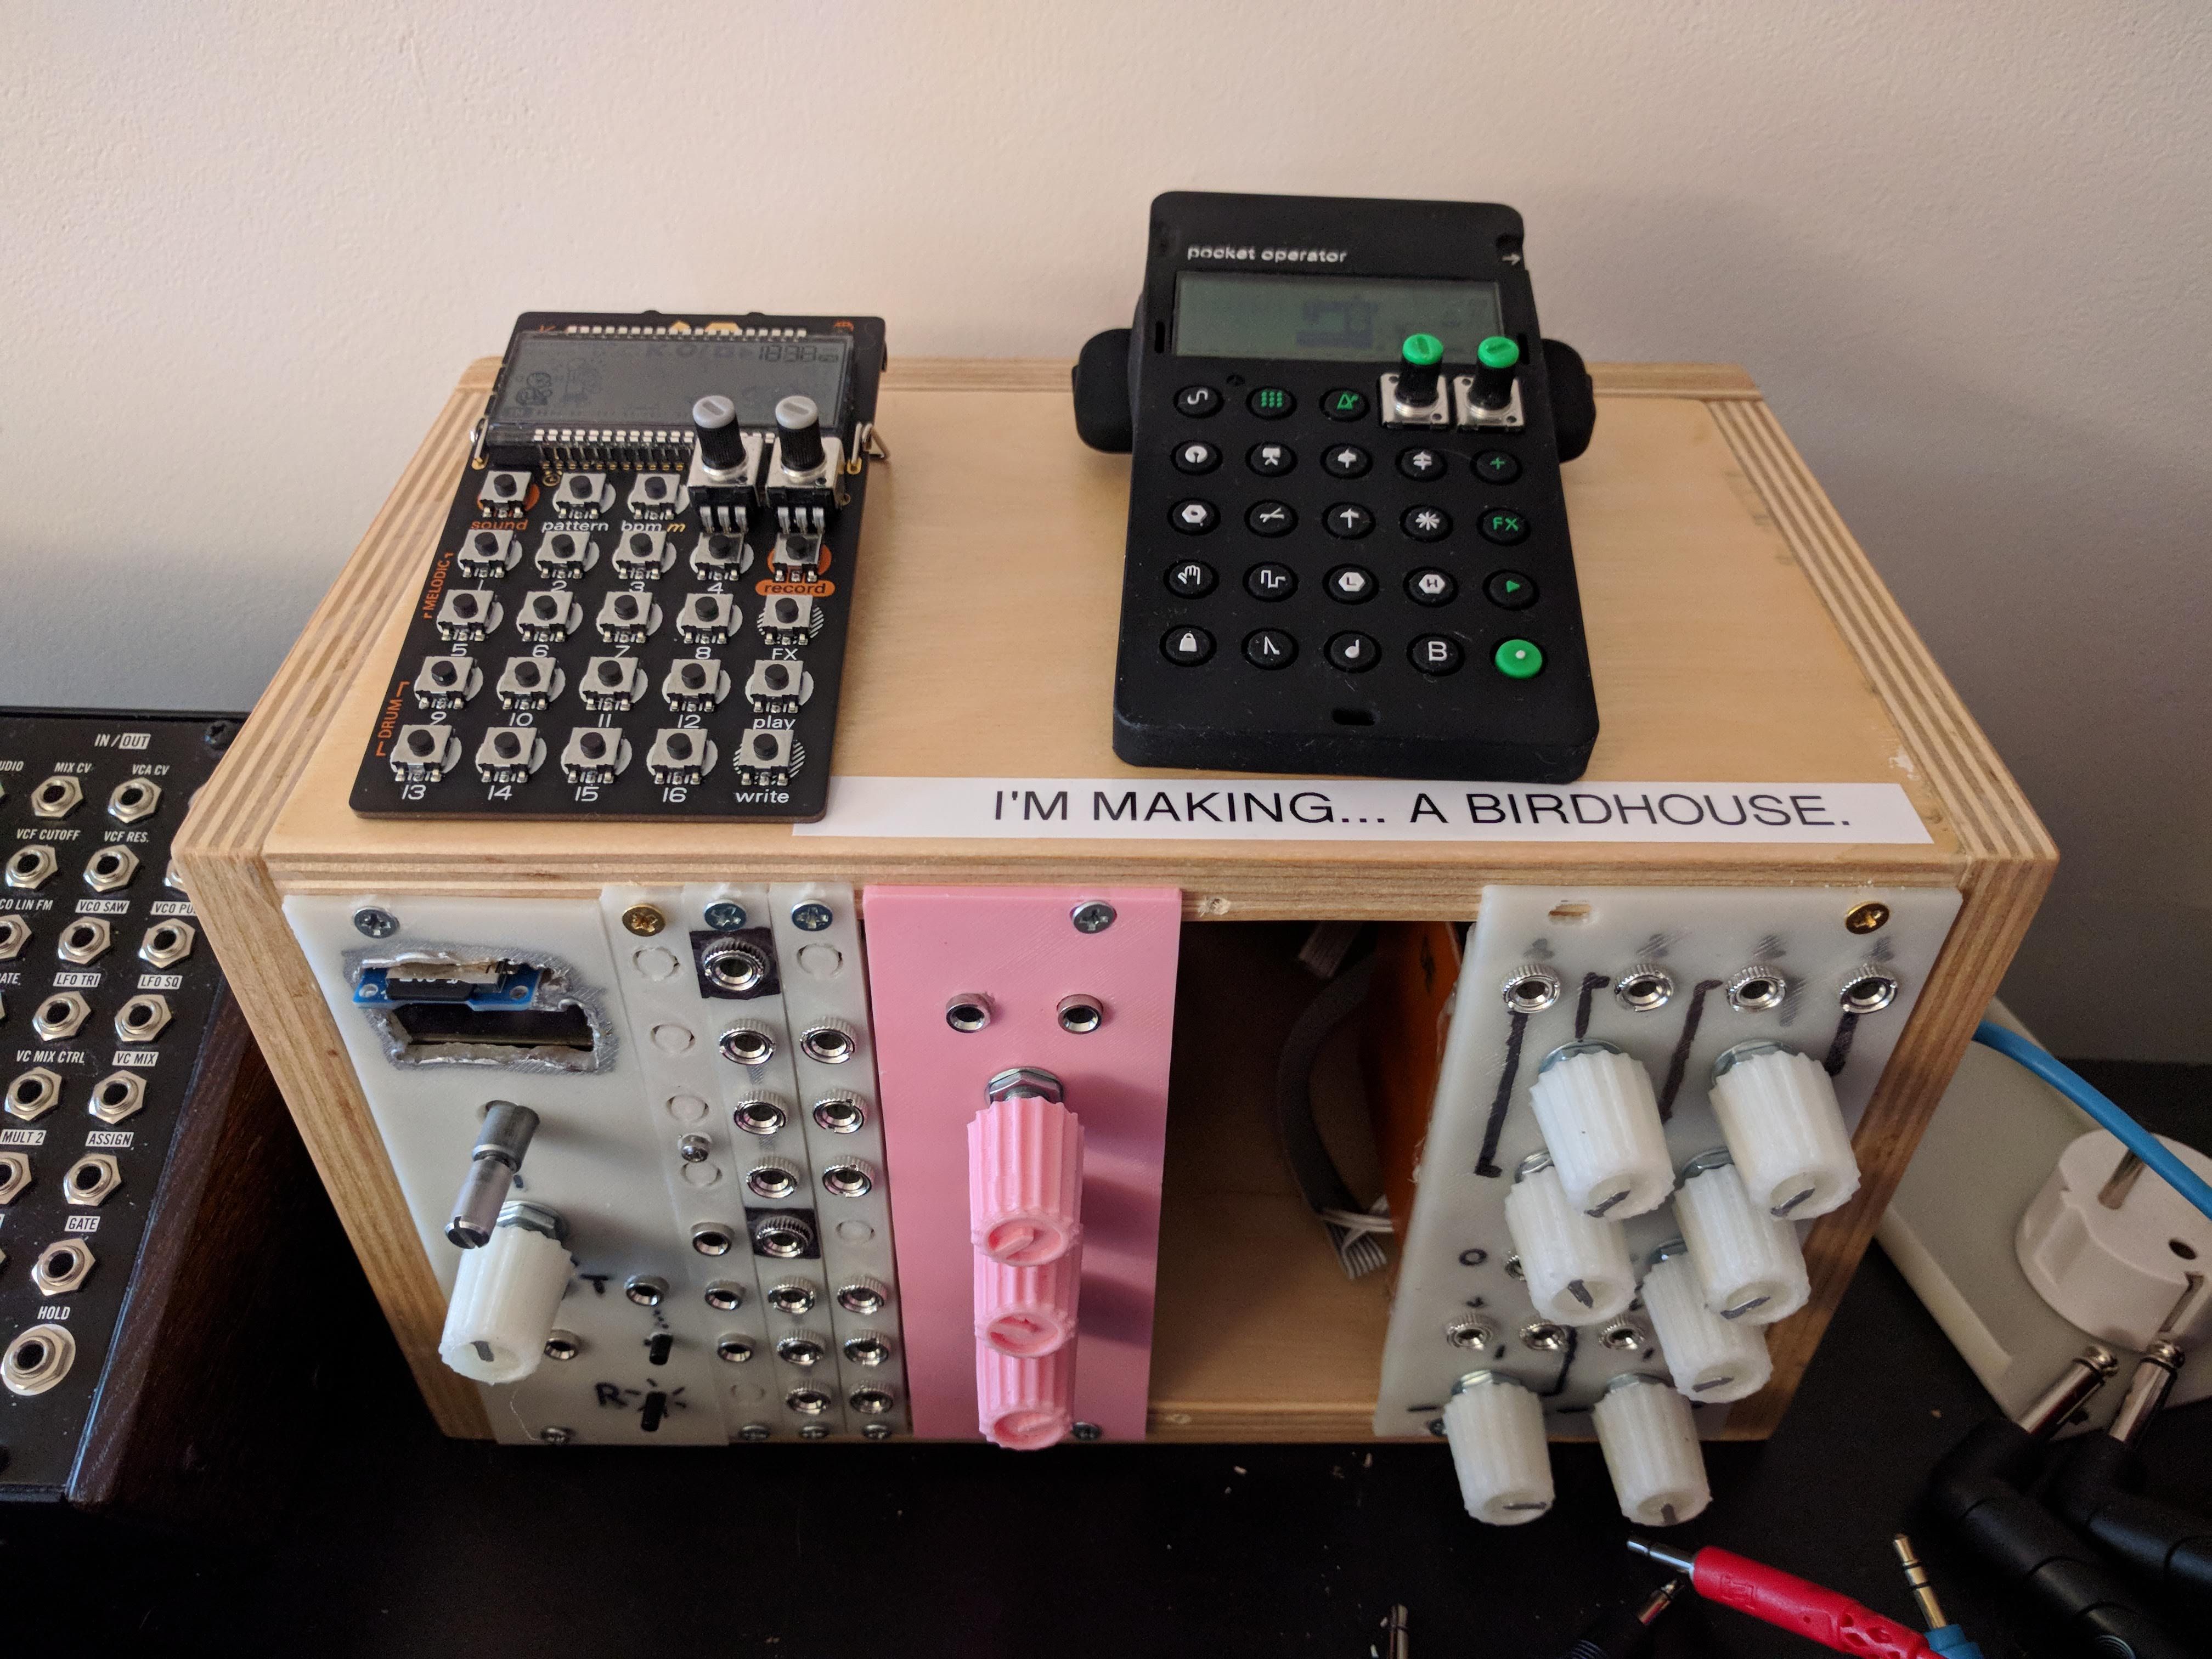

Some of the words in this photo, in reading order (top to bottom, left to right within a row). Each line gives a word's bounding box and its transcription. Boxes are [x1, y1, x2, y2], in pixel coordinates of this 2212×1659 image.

[1187, 246, 1255, 261] pocket
[1261, 249, 1347, 263] operator
[471, 520, 528, 531] sound
[541, 521, 609, 532] pattern
[621, 520, 662, 532] bpm
[1493, 516, 1518, 531] FX
[423, 558, 451, 611] MELODIC
[551, 580, 567, 591] 2
[629, 582, 645, 592] 3
[1346, 577, 1357, 586] L
[1426, 579, 1438, 588] H
[707, 583, 724, 594] 4
[764, 583, 826, 594] record
[450, 643, 468, 656] 5
[532, 644, 549, 657] 6
[614, 645, 630, 658] 7
[695, 647, 712, 659] 8
[772, 648, 798, 661] FX
[1427, 642, 1448, 661] B
[377, 698, 404, 738] DRUM
[430, 712, 447, 725] 9
[509, 713, 533, 726] 10
[678, 714, 701, 729] 12
[753, 715, 796, 730] play
[54, 762, 74, 772] MIX
[76, 763, 92, 773] CV
[132, 765, 152, 775] VCA
[154, 766, 170, 776] CV
[402, 785, 427, 800] 13
[488, 785, 513, 800] 14
[574, 786, 599, 802] 15
[663, 787, 687, 803] 16
[735, 789, 789, 803] write
[995, 791, 1068, 820] I'M
[1092, 791, 1385, 824] MAKING...
[1410, 793, 1448, 823] A
[1466, 794, 1850, 826] BIRDHOUSE.
[16, 829, 37, 839] VCF
[39, 830, 81, 840] CUTOFF
[104, 831, 124, 842] VCF
[126, 832, 149, 843] RES.
[15, 899, 35, 910] LIN
[36, 899, 53, 911] FM
[80, 902, 101, 912] VCO
[103, 902, 127, 913] SAW
[155, 903, 177, 913] VCO
[179, 904, 196, 914] PU
[0, 972, 21, 986] ATE.
[56, 974, 78, 985] LFO
[81, 975, 99, 986] TRI
[140, 976, 161, 987] LFO
[165, 977, 179, 988] SQ
[16, 1050, 31, 1062] VC
[33, 1051, 55, 1063] MIX
[57, 1051, 85, 1063] CTRL
[116, 1053, 131, 1063] VC
[133, 1053, 155, 1064] MIX
[2, 1131, 34, 1143] MULT
[35, 1132, 43, 1143] 2
[88, 1133, 132, 1145] ASSIGN
[69, 1218, 97, 1230] GATE
[37, 1306, 71, 1320] HOLD
